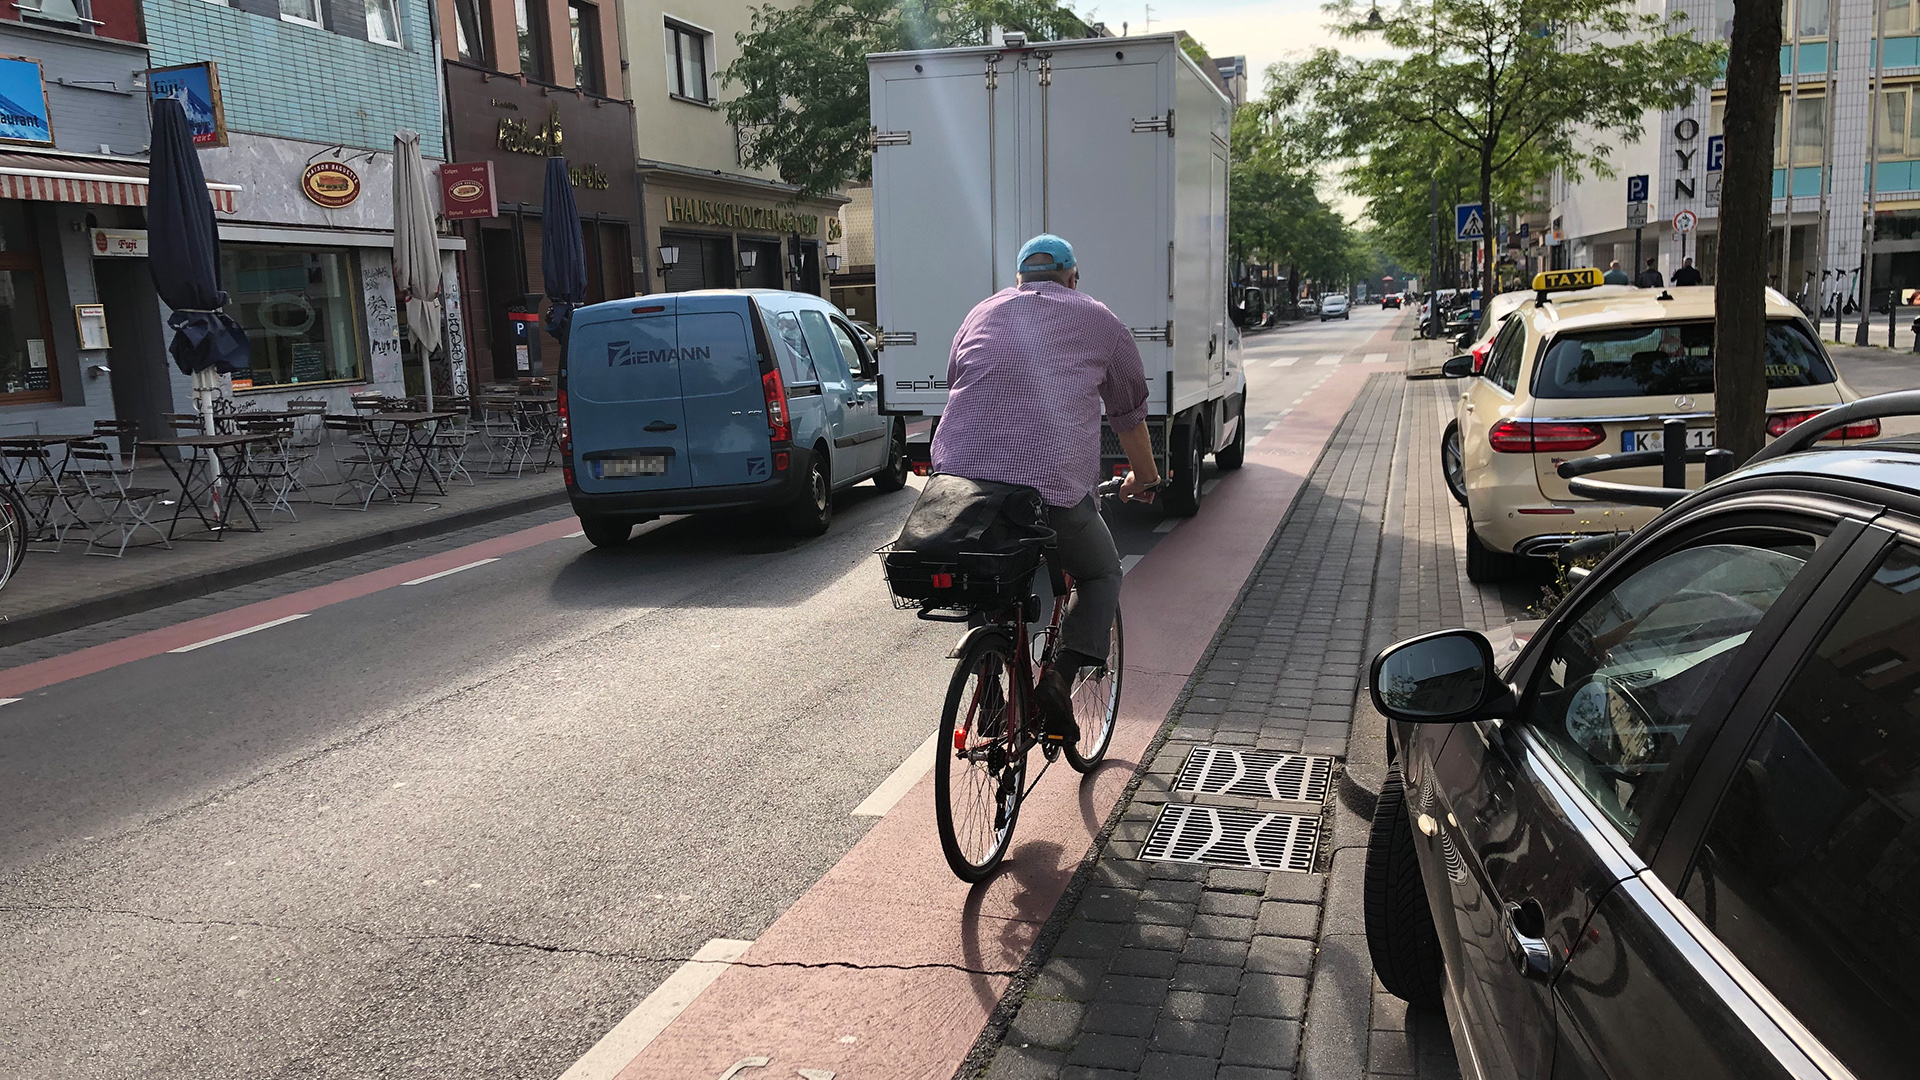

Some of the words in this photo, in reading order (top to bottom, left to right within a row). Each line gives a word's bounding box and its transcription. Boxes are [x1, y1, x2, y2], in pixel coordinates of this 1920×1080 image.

[306, 164, 329, 179] MAISON
[331, 164, 359, 185] BAGUETTE
[1630, 179, 1643, 200] P
[665, 196, 712, 224] HAUS
[714, 202, 782, 231] SCHOLZEN
[118, 239, 137, 252] Fuji
[1547, 272, 1592, 287] TAXI
[516, 322, 525, 335] P
[1636, 433, 1649, 451] K
